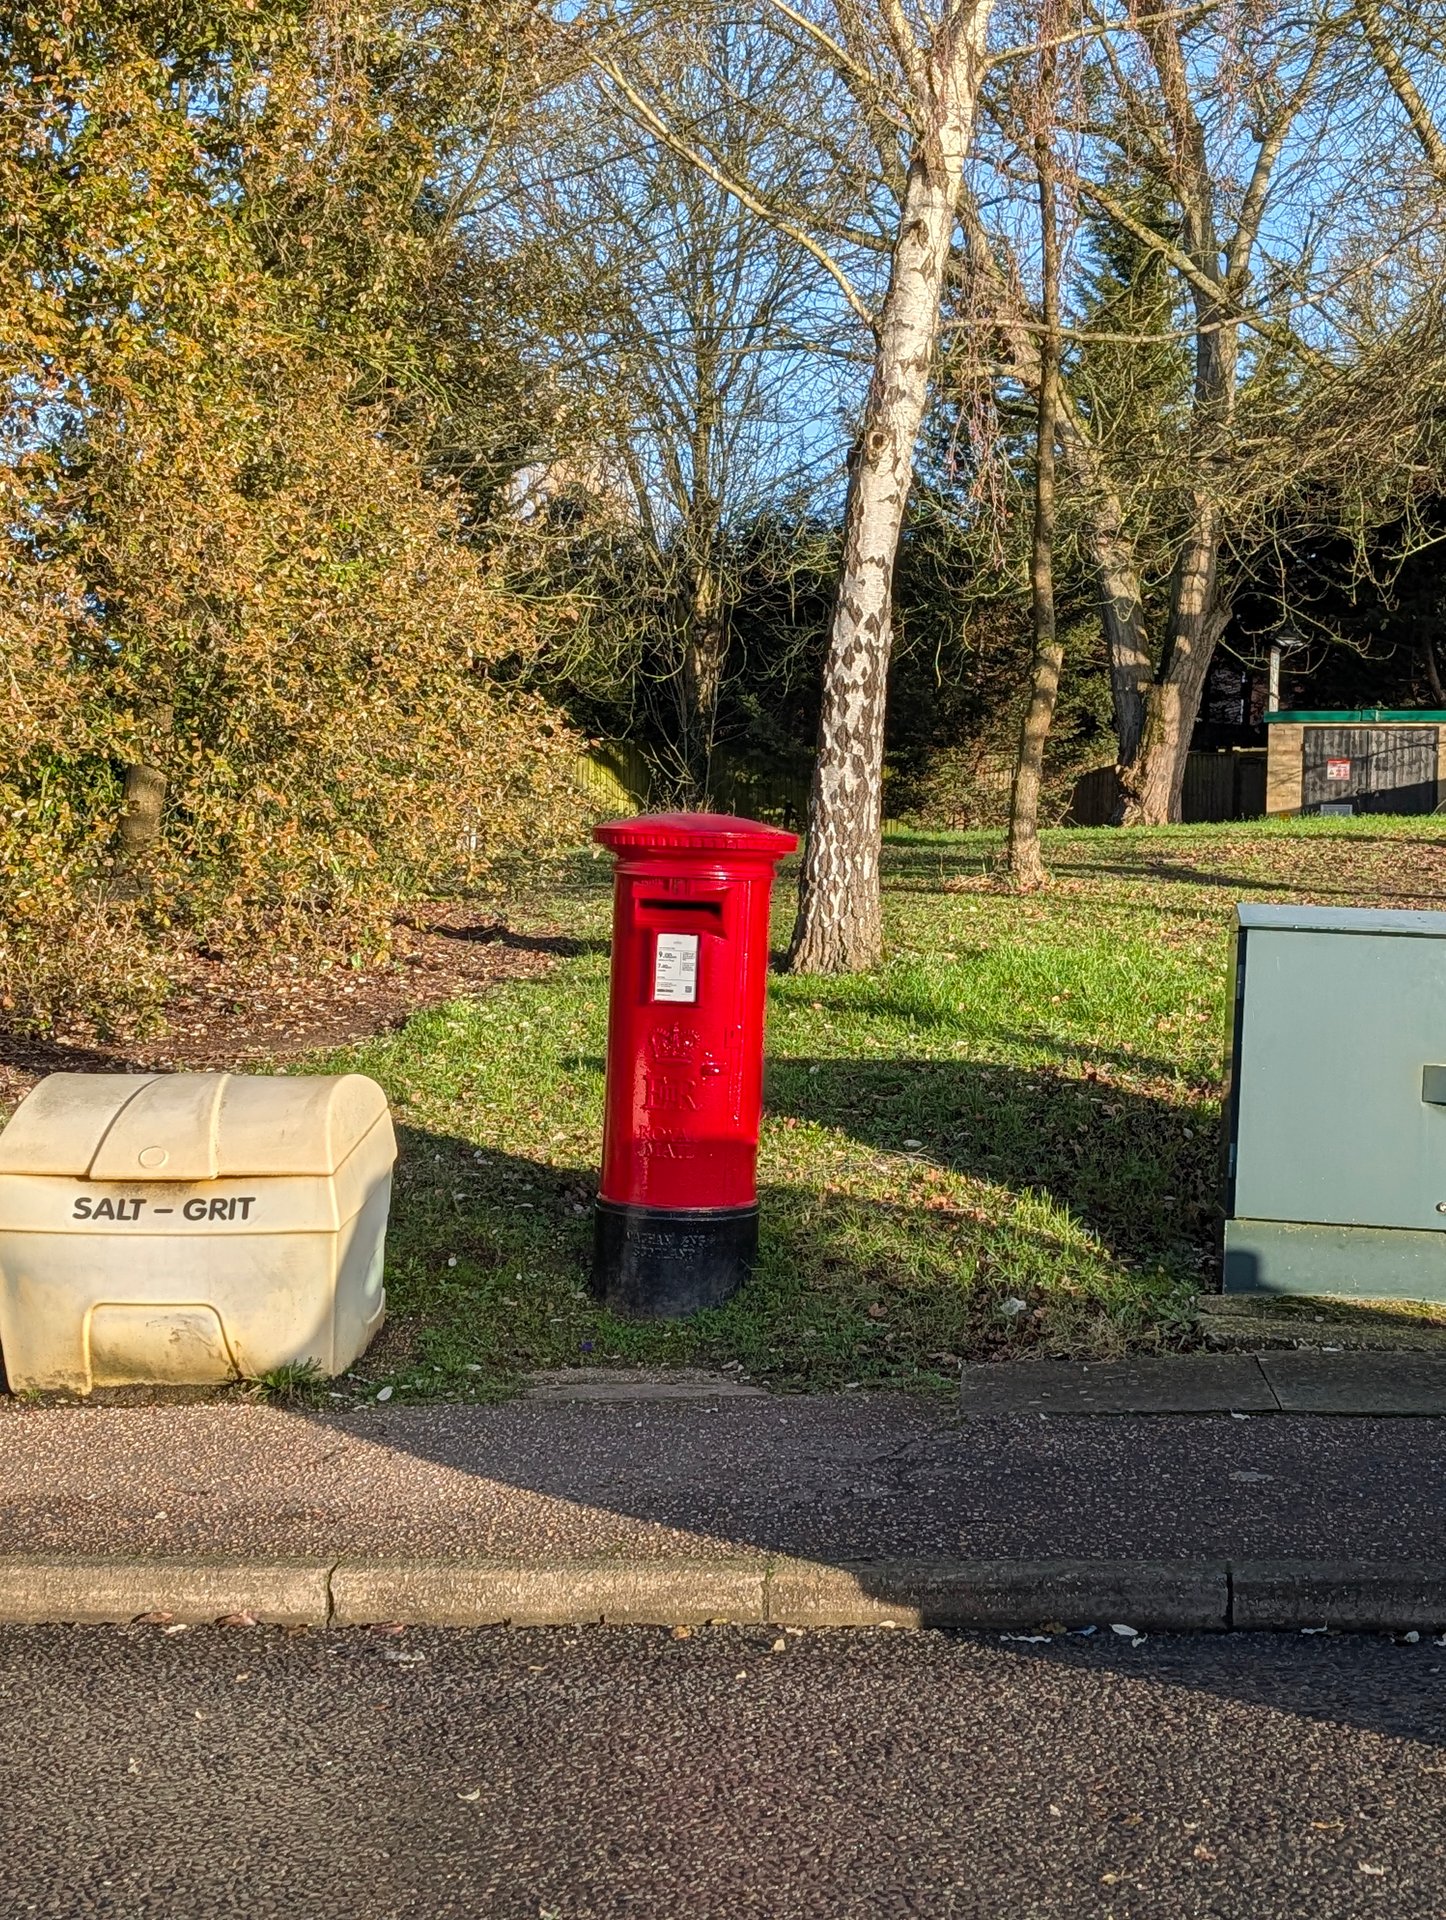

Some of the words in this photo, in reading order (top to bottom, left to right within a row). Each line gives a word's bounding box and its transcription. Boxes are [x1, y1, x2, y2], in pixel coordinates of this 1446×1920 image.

[636, 1143, 695, 1159] MAIL
[72, 1197, 147, 1221] SALT
[182, 1196, 256, 1221] GRIT
